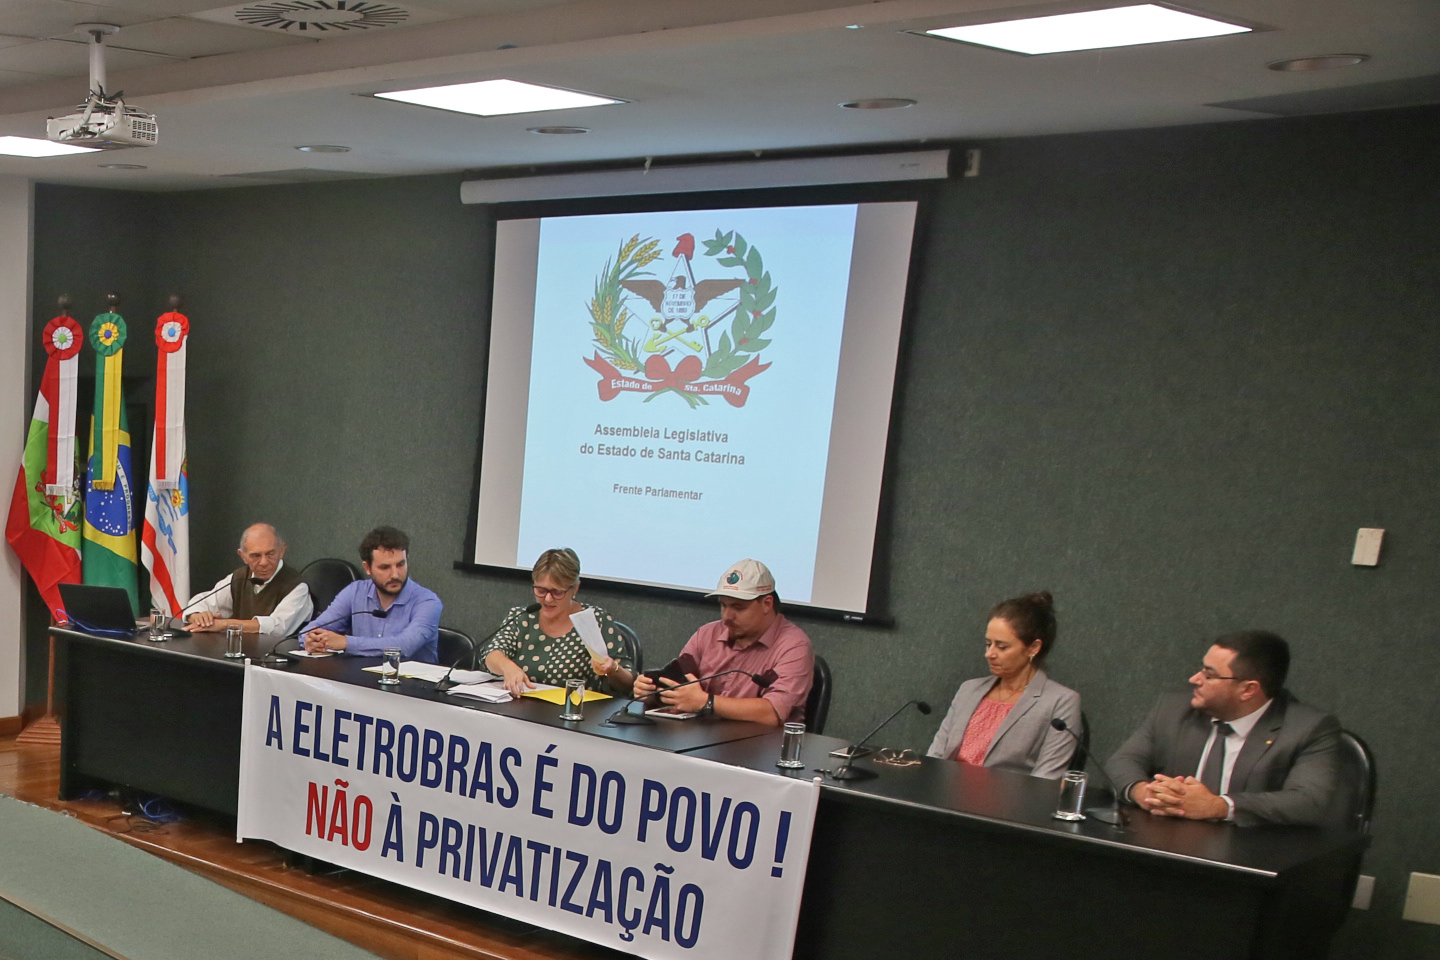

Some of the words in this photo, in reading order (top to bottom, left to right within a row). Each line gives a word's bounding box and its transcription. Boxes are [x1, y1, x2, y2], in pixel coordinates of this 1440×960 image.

[611, 379, 640, 389] Estado
[703, 382, 742, 396] Catarina
[594, 424, 660, 440] Assembleia
[664, 427, 728, 444] Legislativa
[580, 442, 594, 455] do
[597, 444, 636, 458] Estado
[640, 446, 654, 459] de
[657, 447, 691, 462] Santa
[694, 450, 745, 466] Catarina
[613, 484, 642, 496] Frente
[645, 486, 703, 500] Parlamentar
[266, 695, 283, 750] A
[292, 702, 522, 808] ELETROBRAS
[531, 744, 558, 819] É
[568, 764, 626, 836] DO
[637, 778, 760, 871] POVO
[771, 810, 792, 878] !
[305, 778, 373, 852] NÃO
[381, 791, 404, 862] À
[415, 812, 704, 948] PRIVATIZAÇÃO
